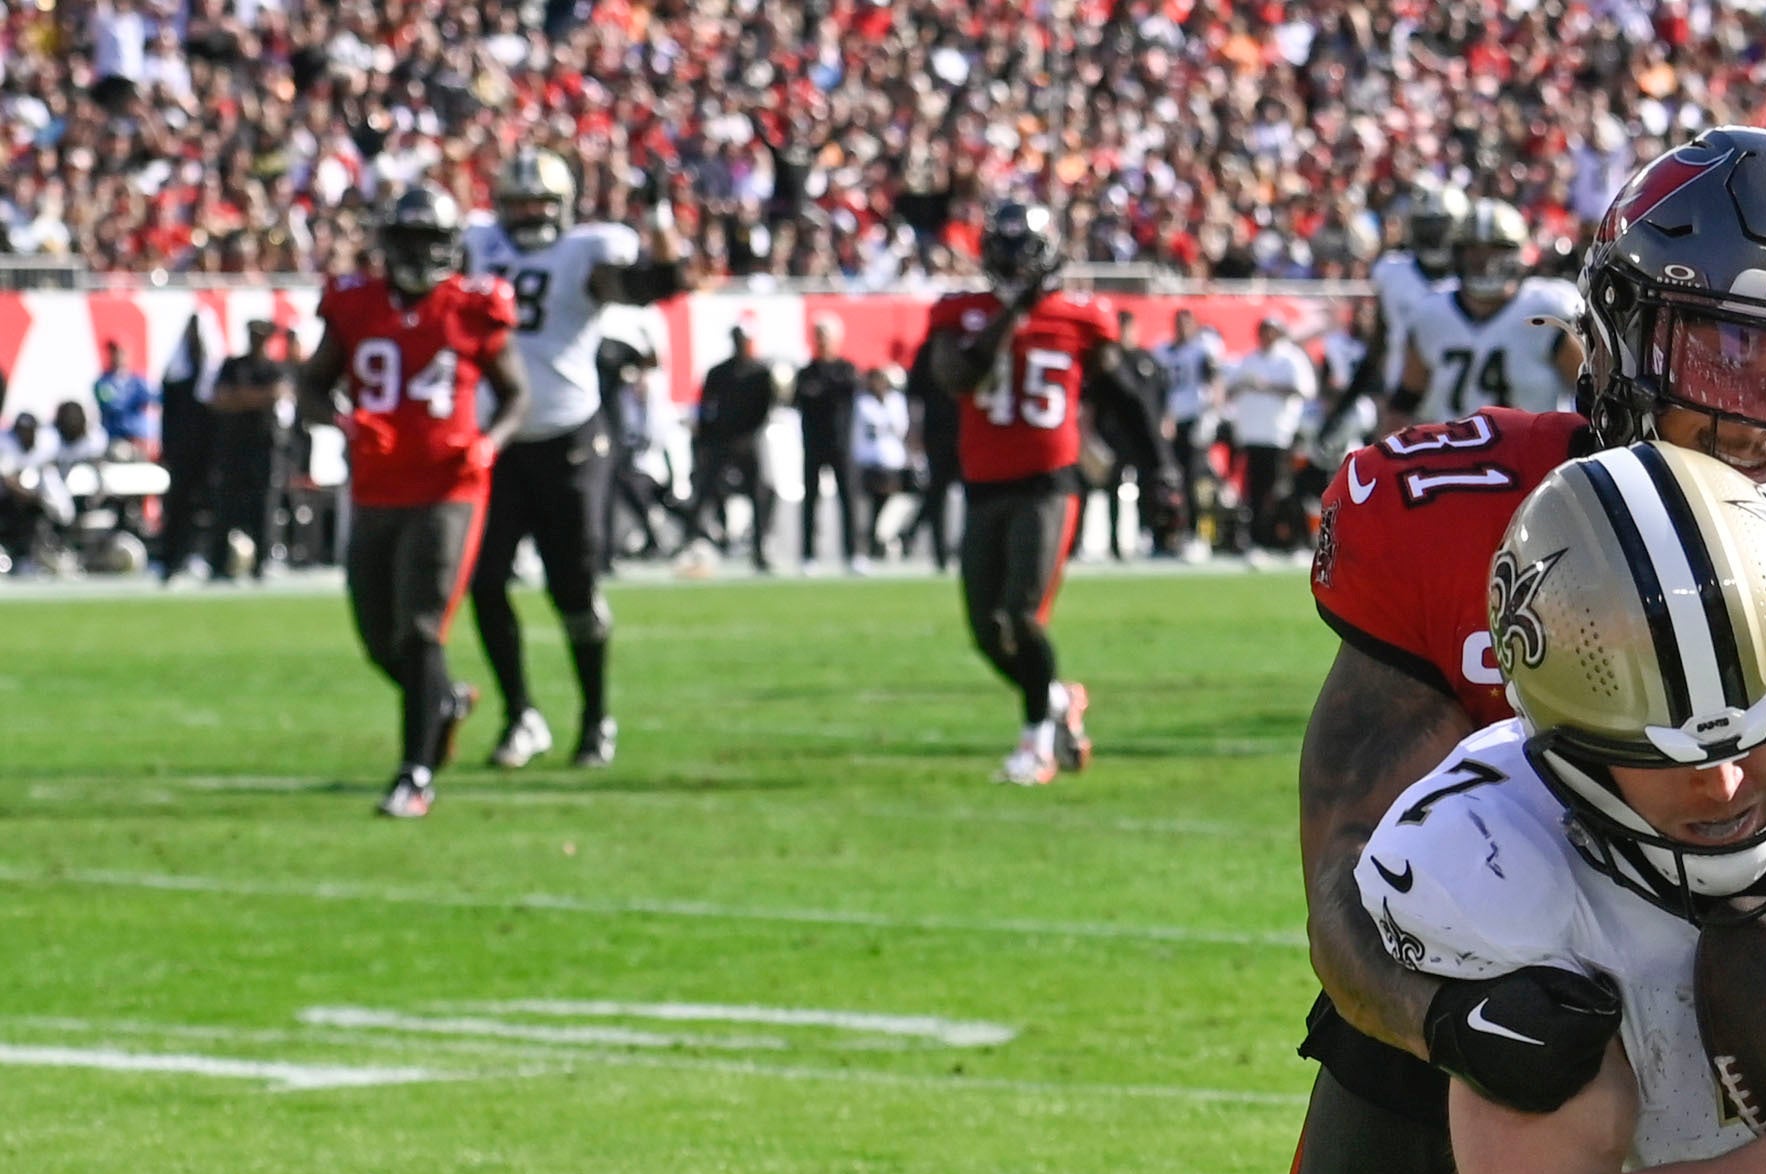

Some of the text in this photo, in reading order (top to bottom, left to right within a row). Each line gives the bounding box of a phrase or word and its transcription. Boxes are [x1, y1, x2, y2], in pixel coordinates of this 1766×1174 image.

[353, 337, 458, 419] 94
[974, 347, 1072, 429] 45
[1441, 347, 1512, 414] 74
[1381, 413, 1514, 503] 31
[1395, 757, 1510, 827] 7
